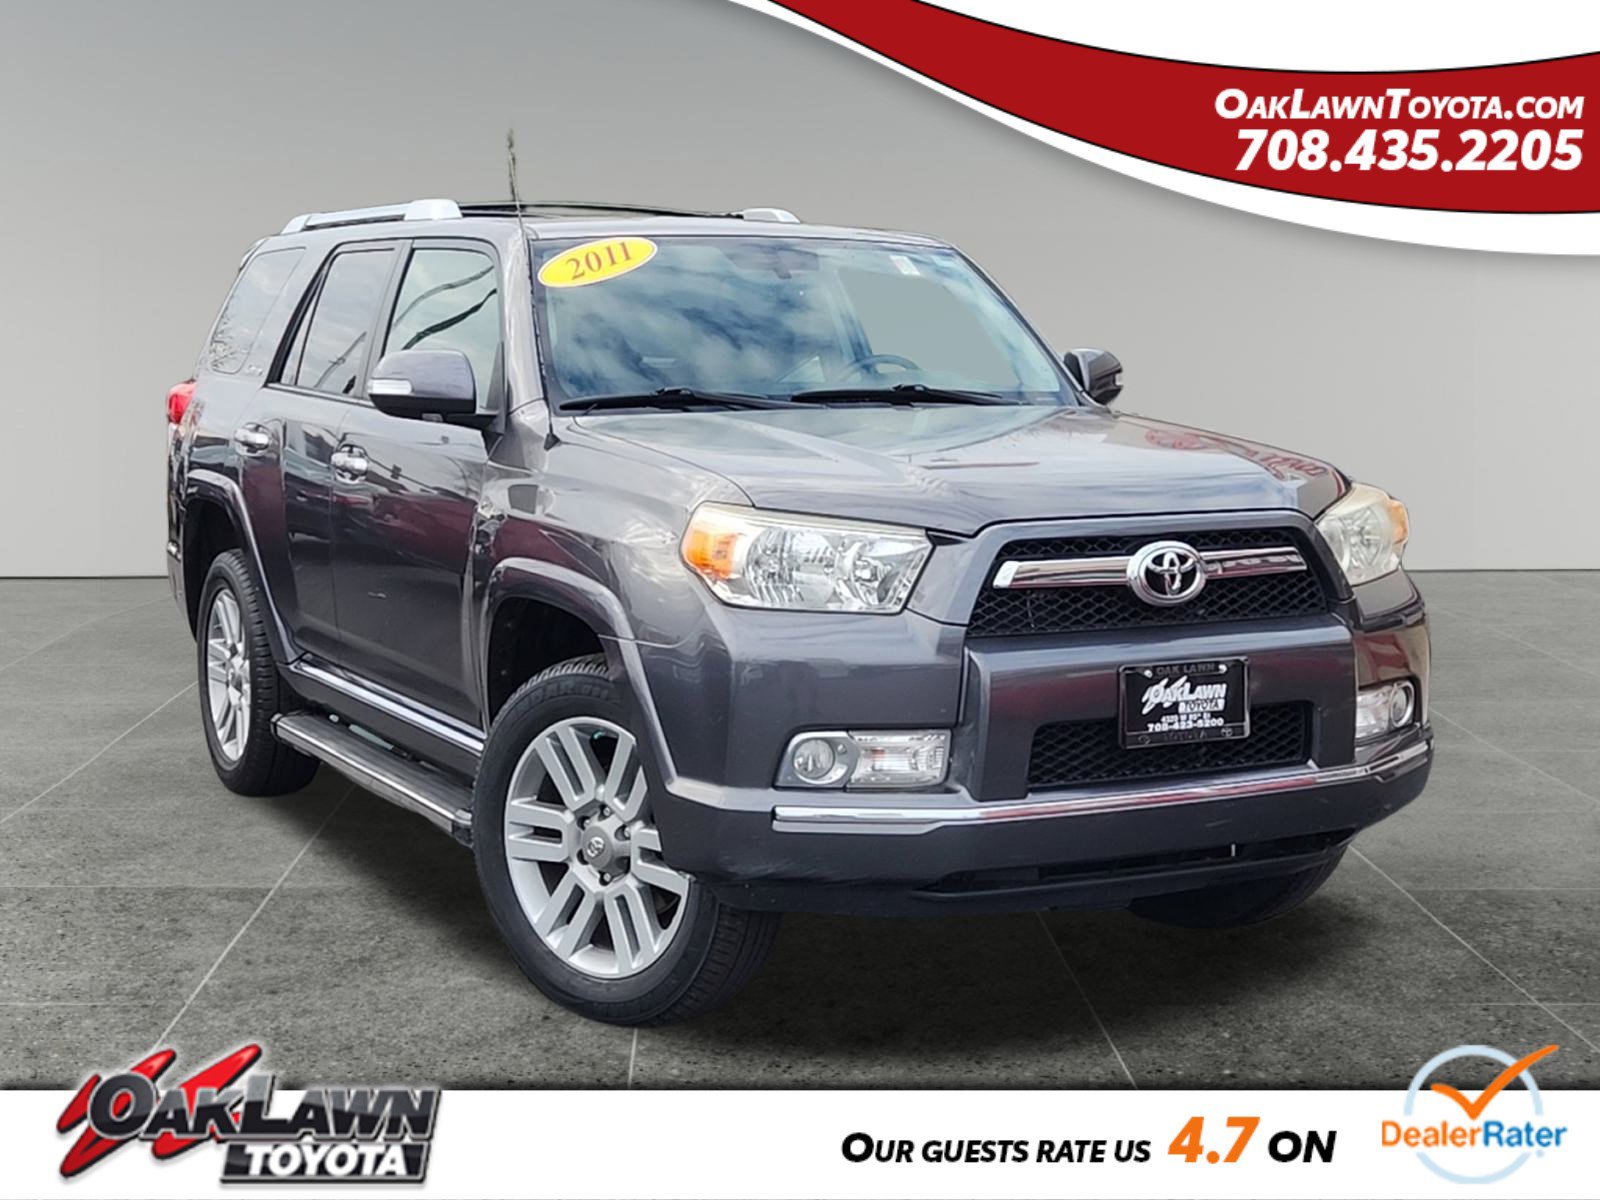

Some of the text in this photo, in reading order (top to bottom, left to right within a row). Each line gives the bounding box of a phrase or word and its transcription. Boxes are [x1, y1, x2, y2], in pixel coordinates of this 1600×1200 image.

[565, 241, 632, 280] 2011
[1156, 663, 1215, 675] OAK LAWN
[1184, 700, 1220, 712] TOYOTA
